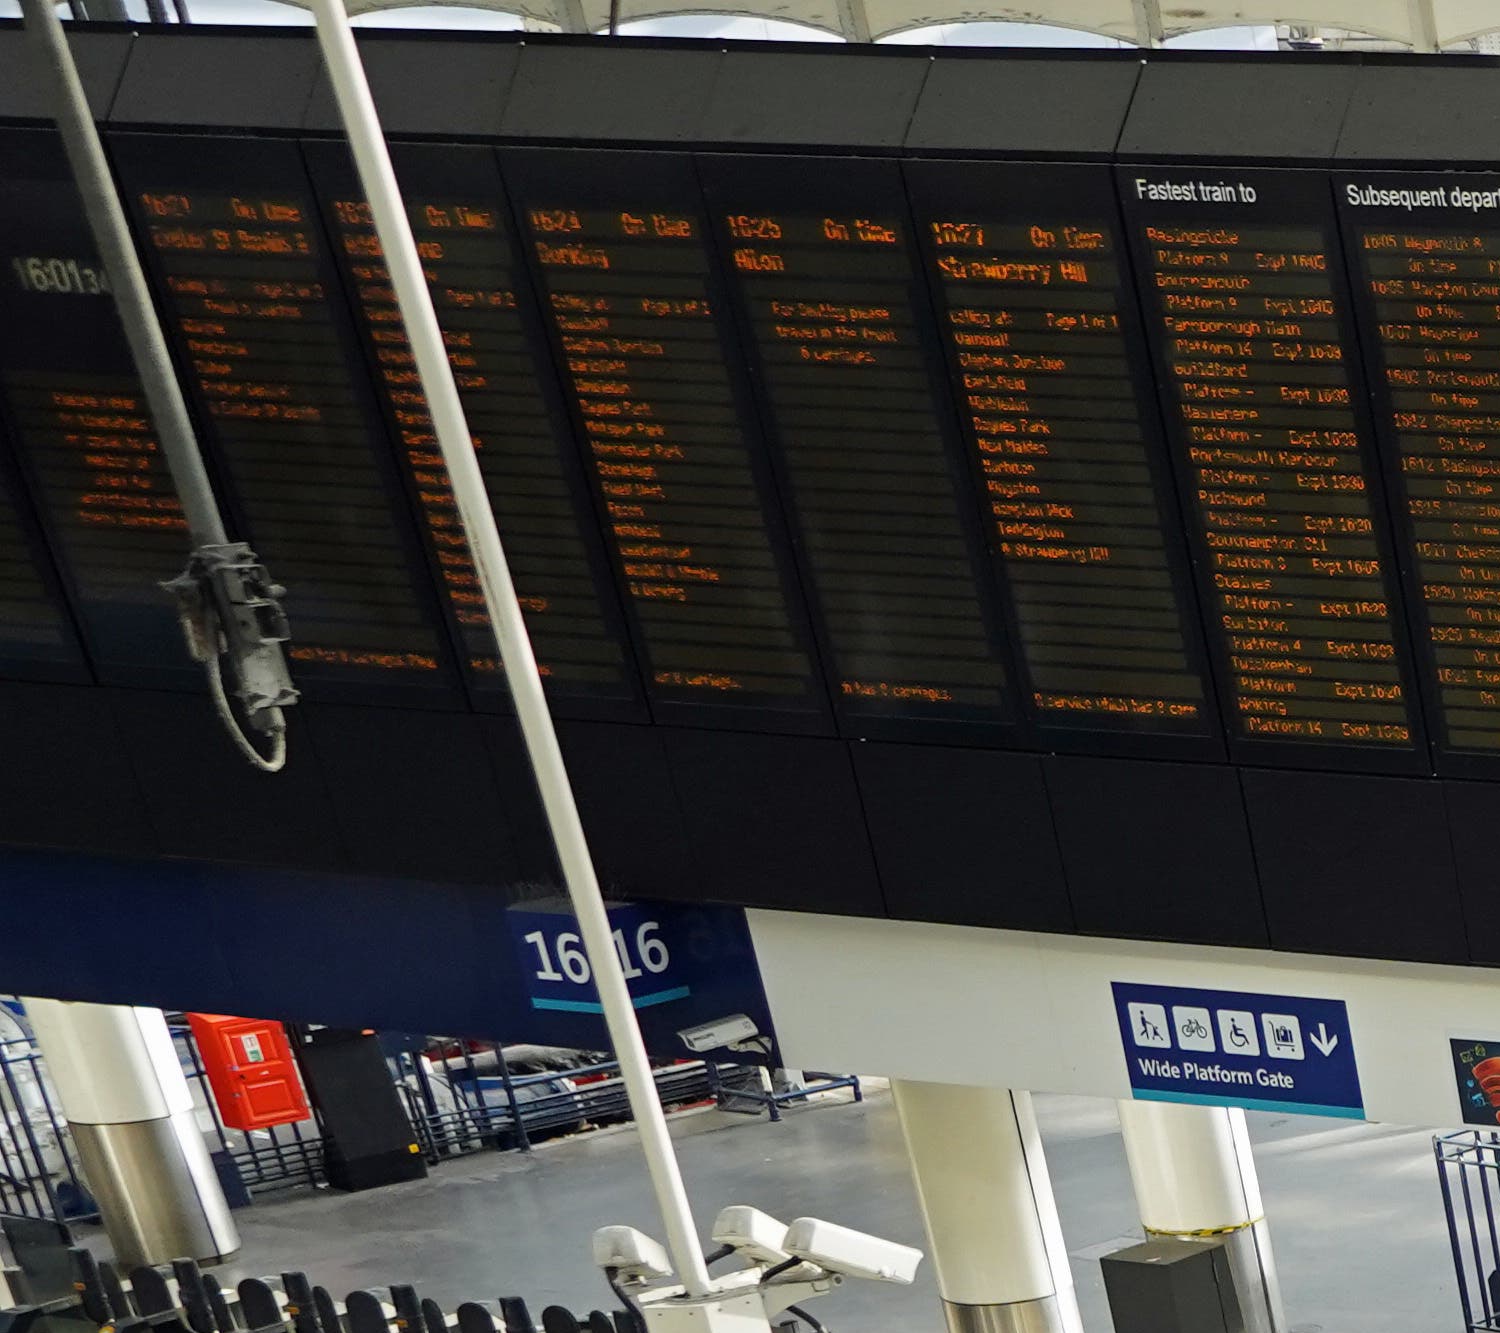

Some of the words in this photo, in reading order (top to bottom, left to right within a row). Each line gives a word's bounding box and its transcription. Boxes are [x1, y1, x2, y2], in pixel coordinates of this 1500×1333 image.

[1136, 178, 1199, 201] Fastest
[1199, 181, 1236, 202] train
[1239, 186, 1257, 203] to
[1346, 184, 1447, 211] Subsequent
[525, 931, 591, 984] 16
[612, 921, 670, 979] 16
[1138, 1058, 1181, 1079] Wide
[1184, 1062, 1253, 1085] Platform
[1256, 1069, 1295, 1088] Gate
